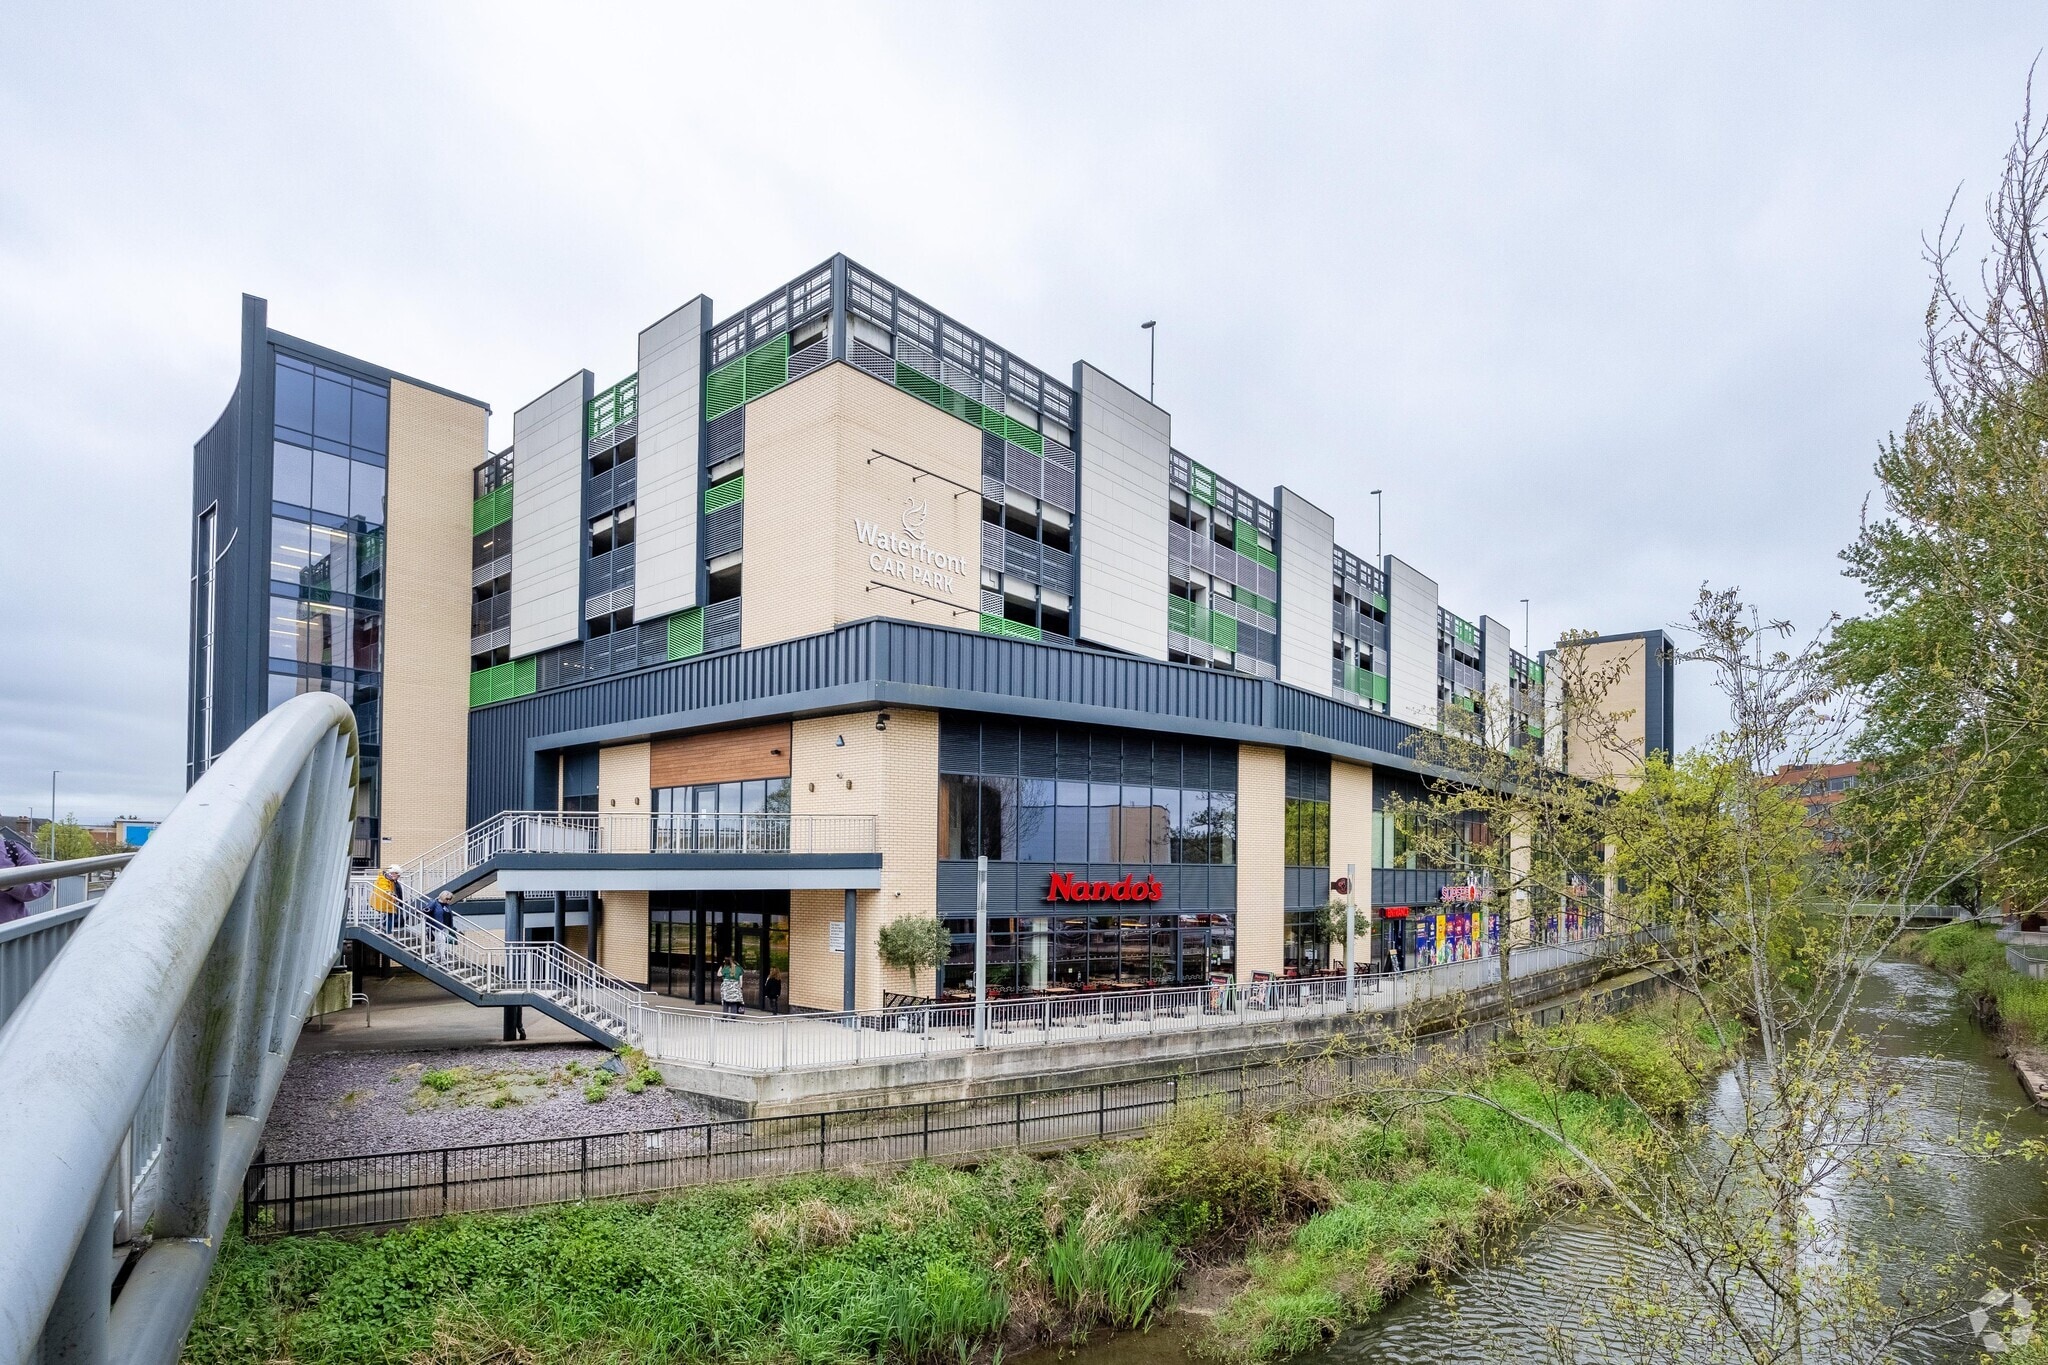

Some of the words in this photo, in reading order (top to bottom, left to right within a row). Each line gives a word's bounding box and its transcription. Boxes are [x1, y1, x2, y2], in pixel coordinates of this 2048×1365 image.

[854, 517, 967, 577] Waterfront
[869, 552, 906, 580] CAR
[911, 565, 953, 594] PARK
[1047, 872, 1163, 901] Nando's
